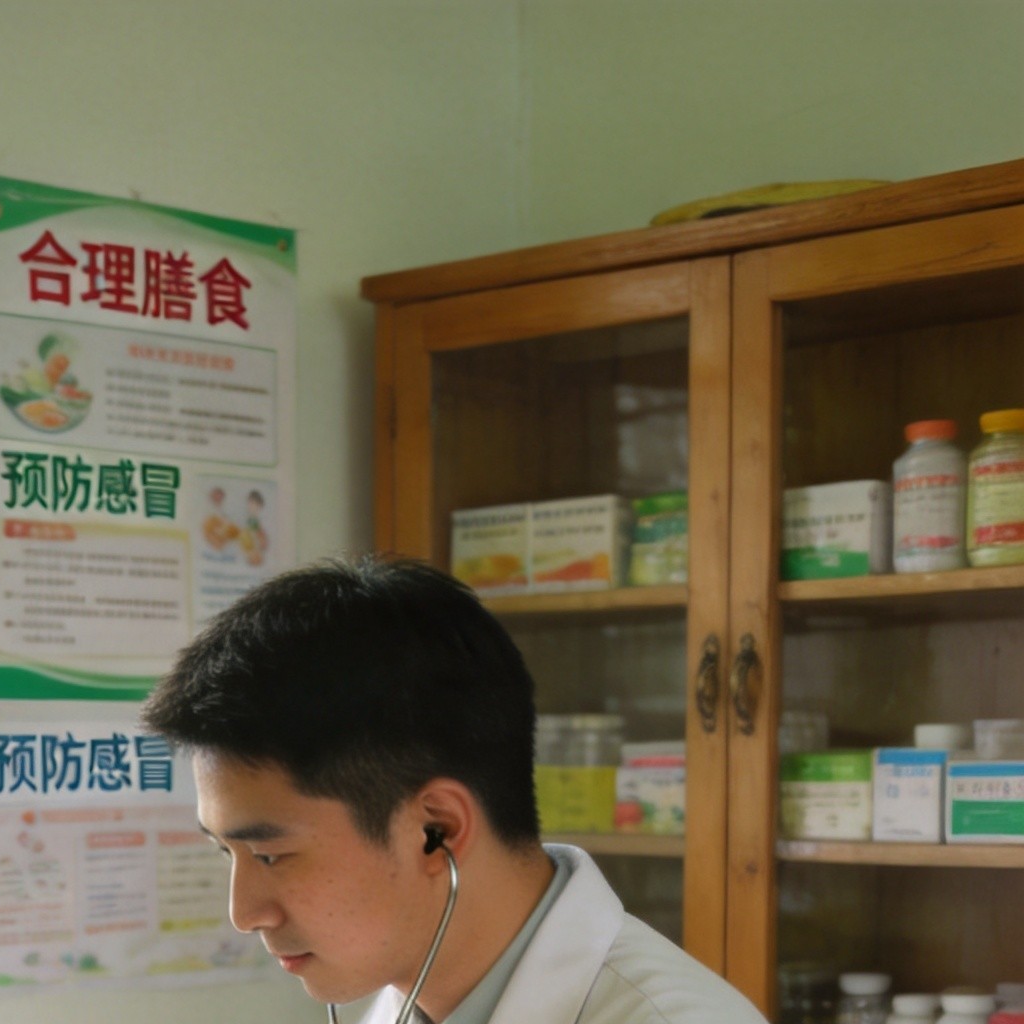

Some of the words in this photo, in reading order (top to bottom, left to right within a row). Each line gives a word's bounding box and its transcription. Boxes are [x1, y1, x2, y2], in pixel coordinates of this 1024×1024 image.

[19, 229, 252, 330] 合理膳食
[1, 450, 180, 519] 预防感冒
